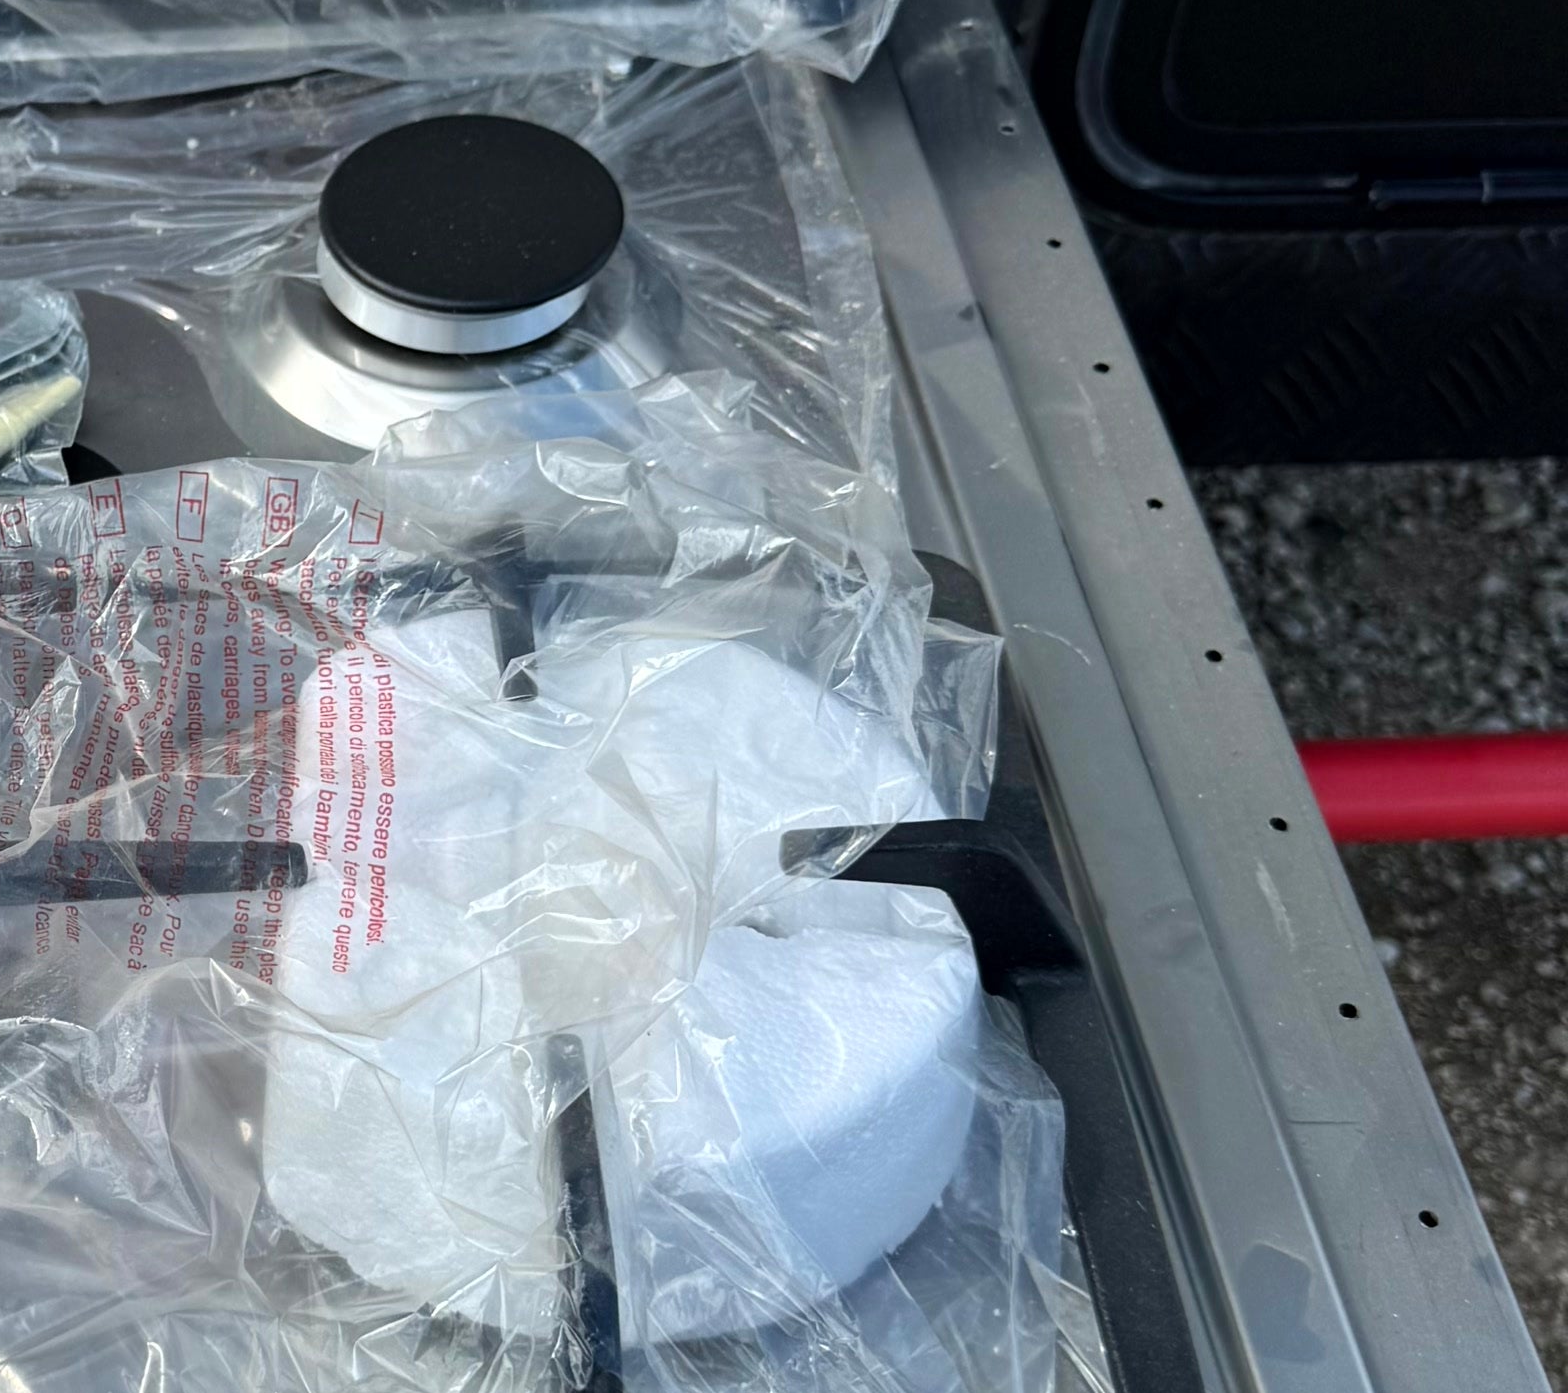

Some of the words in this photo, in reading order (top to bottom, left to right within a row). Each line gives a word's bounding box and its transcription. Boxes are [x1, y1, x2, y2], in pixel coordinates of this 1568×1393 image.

[94, 495, 114, 510] E
[182, 498, 202, 516] F
[270, 493, 290, 533] GB
[145, 545, 163, 563] la
[193, 589, 211, 635] sacs
[247, 608, 267, 657] away
[191, 642, 207, 666] de
[279, 645, 296, 666] To
[317, 648, 335, 690] fuori
[347, 657, 364, 666] il
[372, 655, 390, 669] di
[220, 635, 241, 724] carriages,
[253, 663, 270, 704] from
[320, 696, 335, 728] dalla
[346, 673, 363, 732] pericolo
[376, 674, 394, 736] plastica
[69, 694, 111, 791] mantenga
[319, 732, 335, 766] portata
[349, 737, 366, 750] di
[320, 768, 338, 784] dei
[378, 740, 396, 787] possono
[312, 789, 335, 866] bambini.
[372, 792, 394, 859] essere
[339, 860, 359, 919] tenere
[366, 864, 387, 946] pericolosi.
[234, 899, 251, 934] use
[261, 919, 281, 947] this
[129, 922, 148, 956] sac
[159, 914, 181, 957] Pour
[331, 924, 351, 973] questo
[126, 958, 147, 971] à
[230, 939, 247, 969] this
[256, 953, 277, 987] plas
